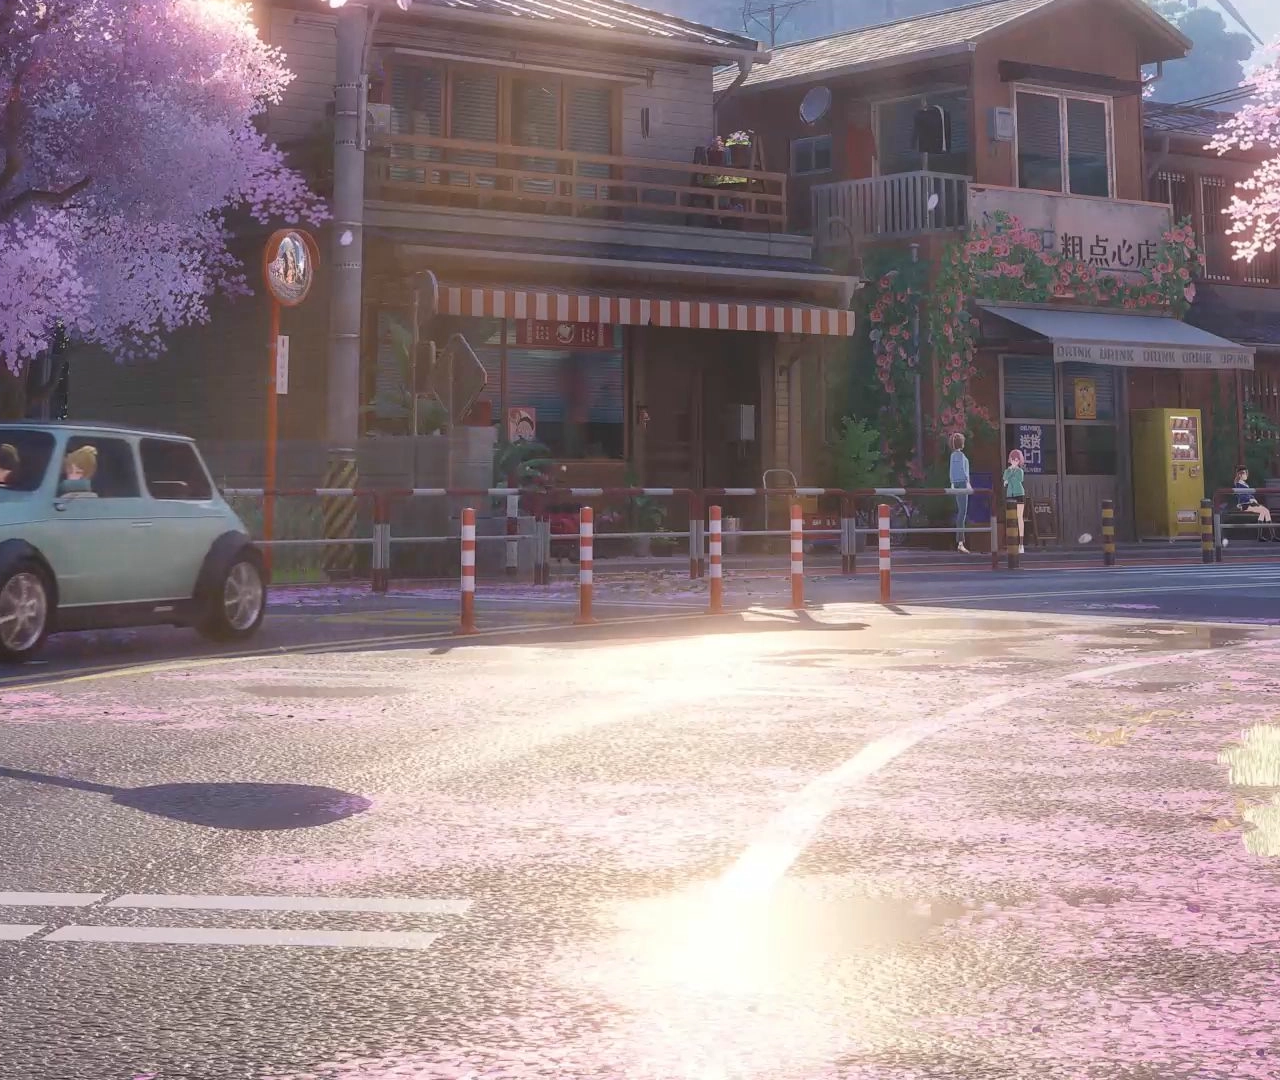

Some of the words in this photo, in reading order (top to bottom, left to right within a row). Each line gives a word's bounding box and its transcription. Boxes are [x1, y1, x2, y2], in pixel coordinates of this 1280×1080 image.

[1060, 231, 1158, 268] 粗点心店
[1056, 345, 1092, 359] DRINK
[1099, 347, 1135, 361] DRINK
[1143, 350, 1176, 363] DRINK
[1182, 351, 1213, 364] DRINK
[1220, 353, 1250, 365] DRINK
[1020, 434, 1041, 448] 送货
[1024, 449, 1041, 464] 上门
